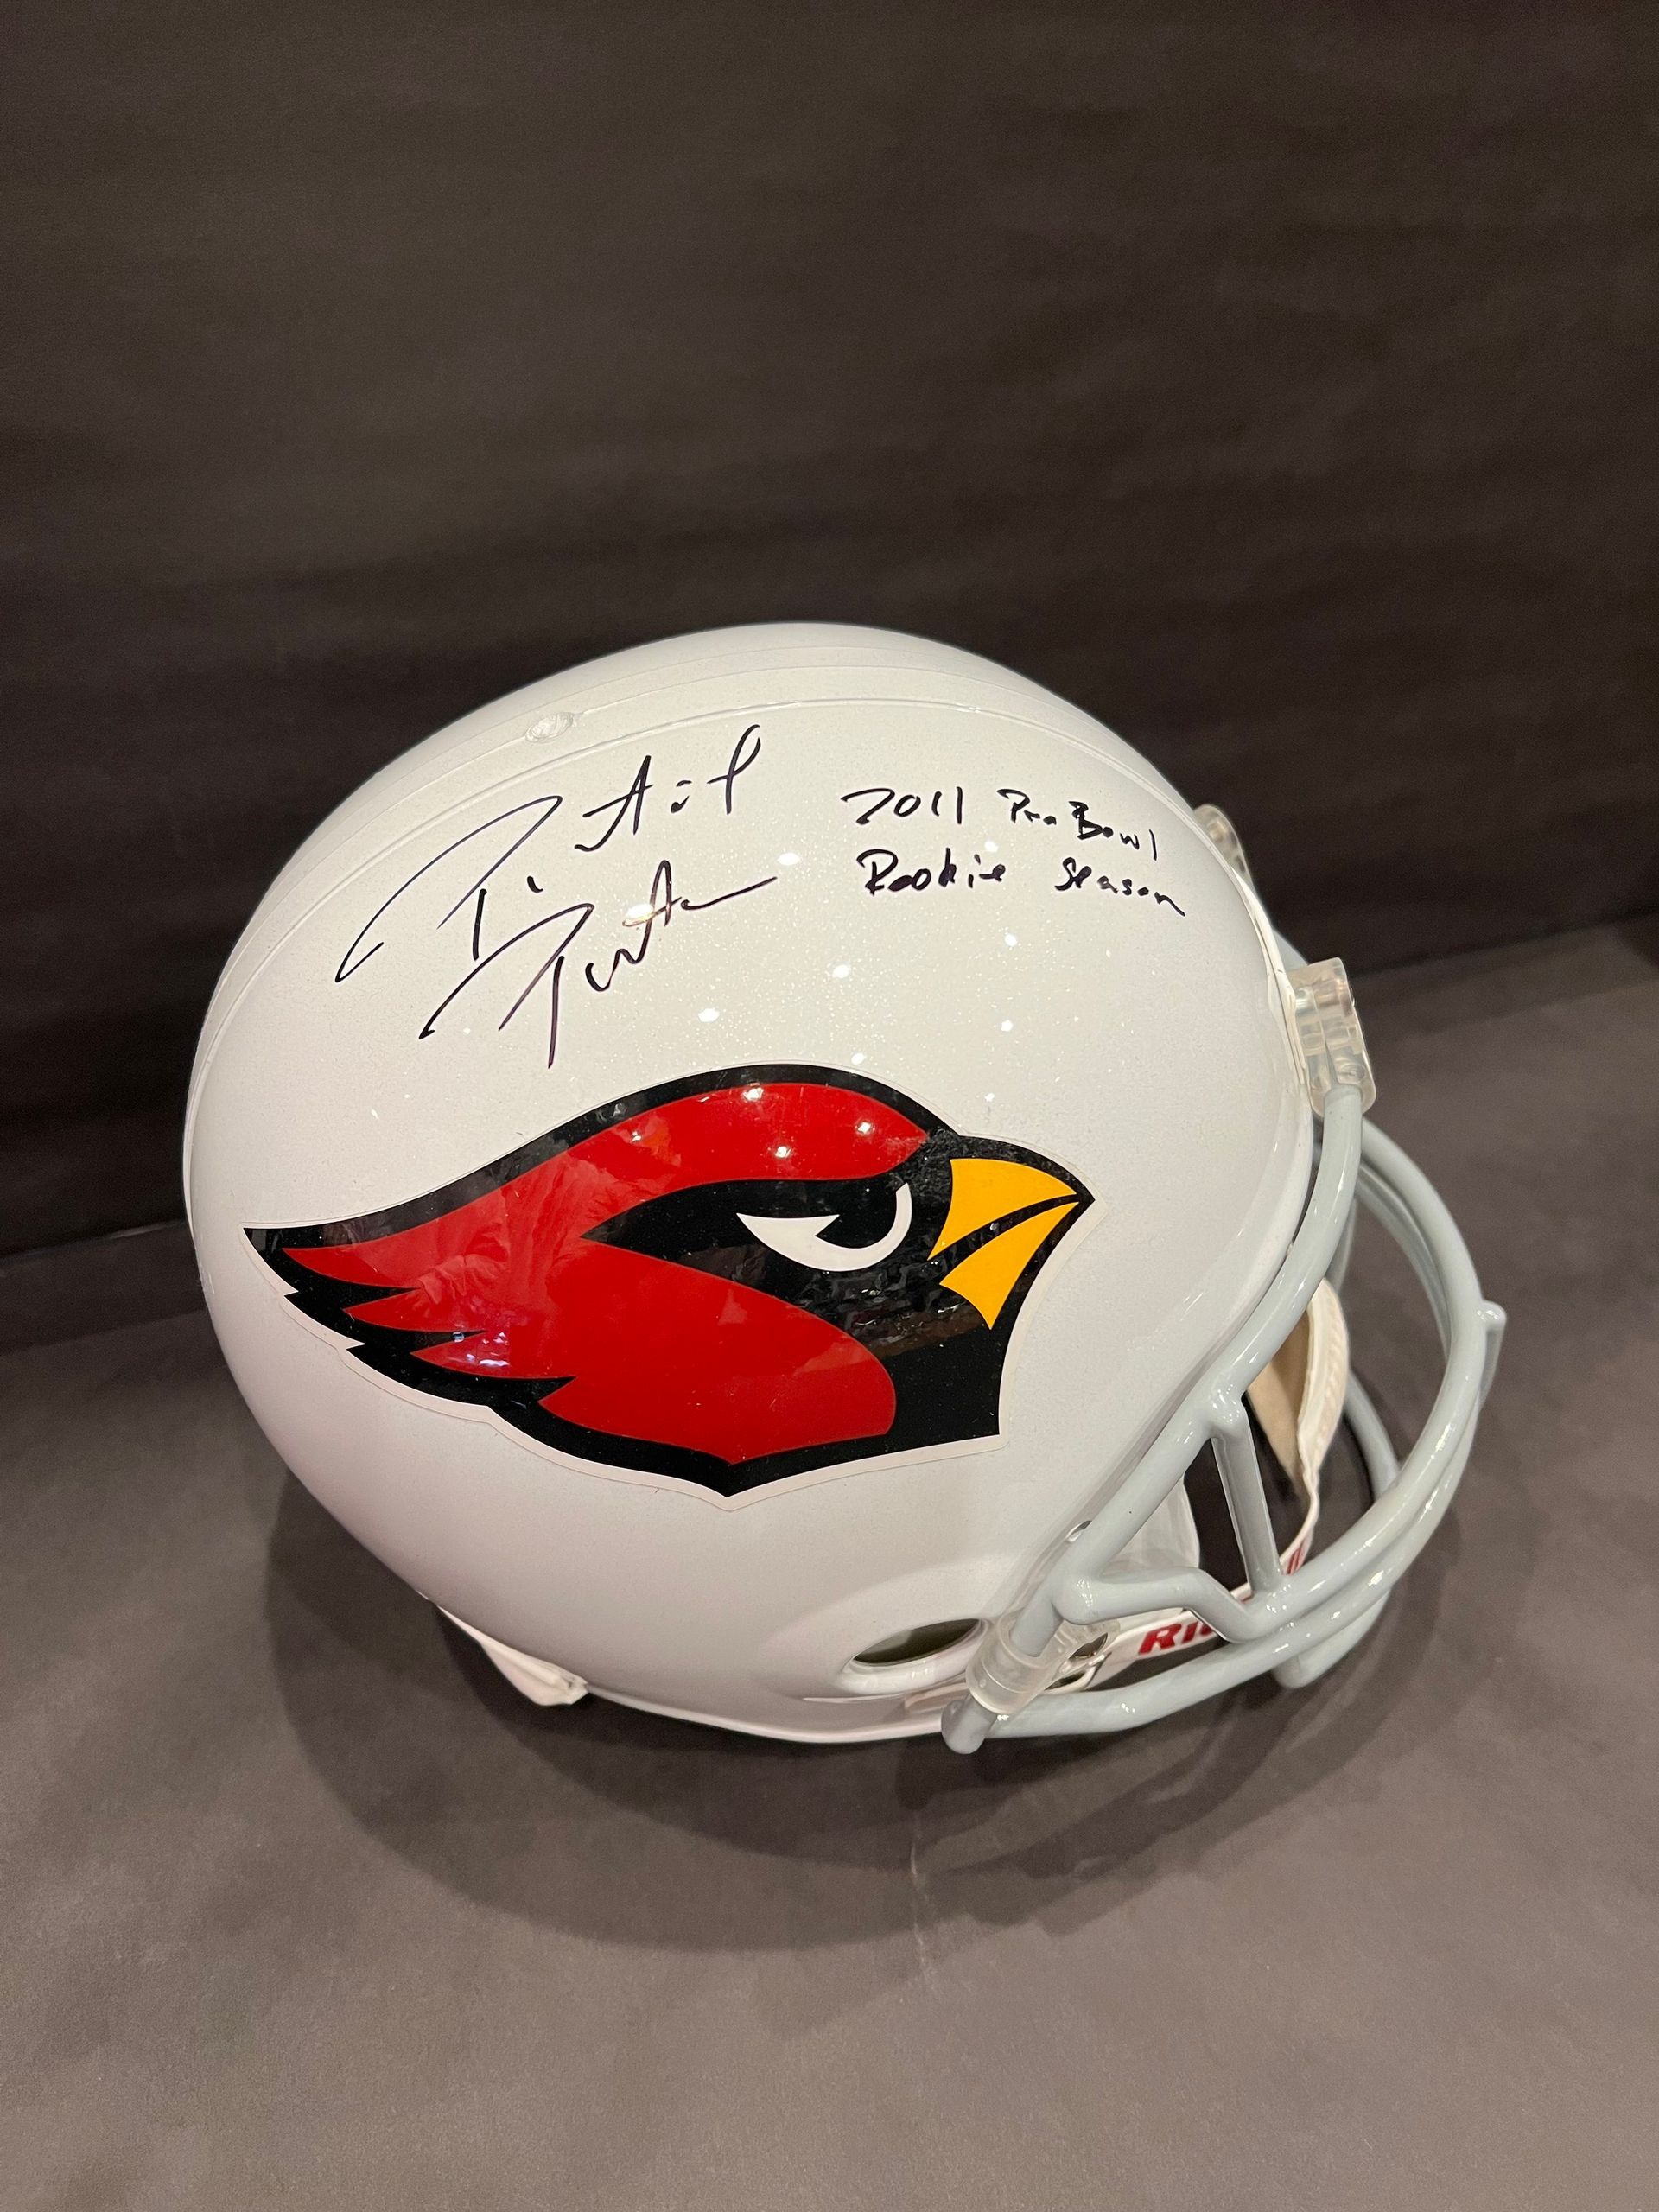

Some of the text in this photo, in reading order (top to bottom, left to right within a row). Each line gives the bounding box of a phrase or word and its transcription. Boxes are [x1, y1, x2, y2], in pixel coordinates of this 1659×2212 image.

[840, 786, 1158, 861] 2011 Pro Bowl
[855, 847, 1186, 917] Rookie Season
